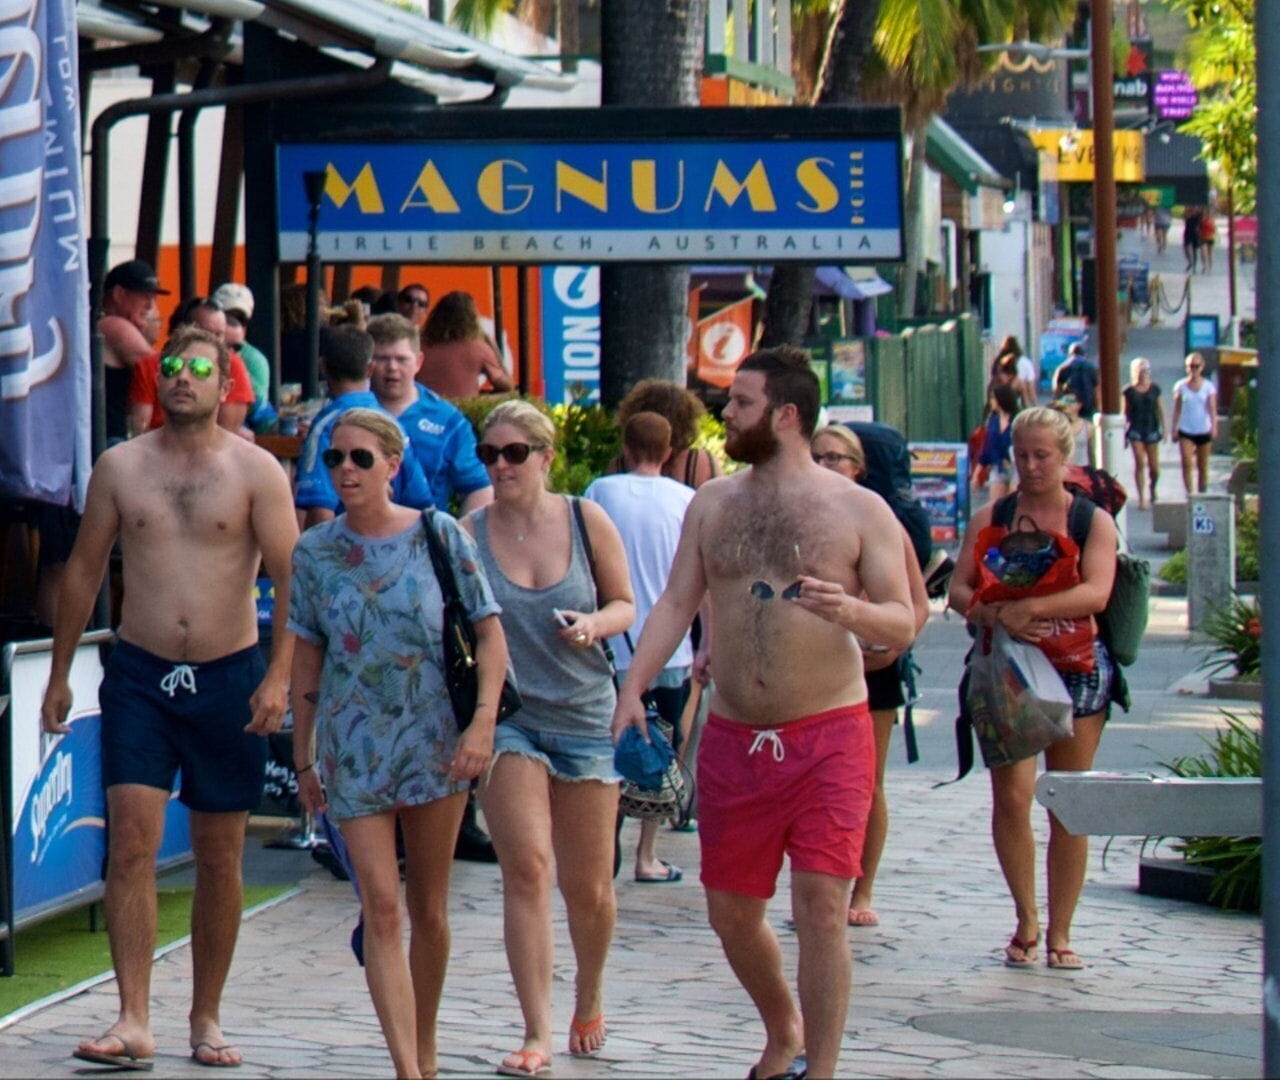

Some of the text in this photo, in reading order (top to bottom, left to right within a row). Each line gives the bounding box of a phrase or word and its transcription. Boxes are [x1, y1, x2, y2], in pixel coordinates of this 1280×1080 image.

[1114, 80, 1148, 96] nab
[323, 156, 840, 215] MAGNUMS
[333, 234, 872, 254] IRLIE BEACH, AUSTRALIA
[562, 316, 601, 404] ION
